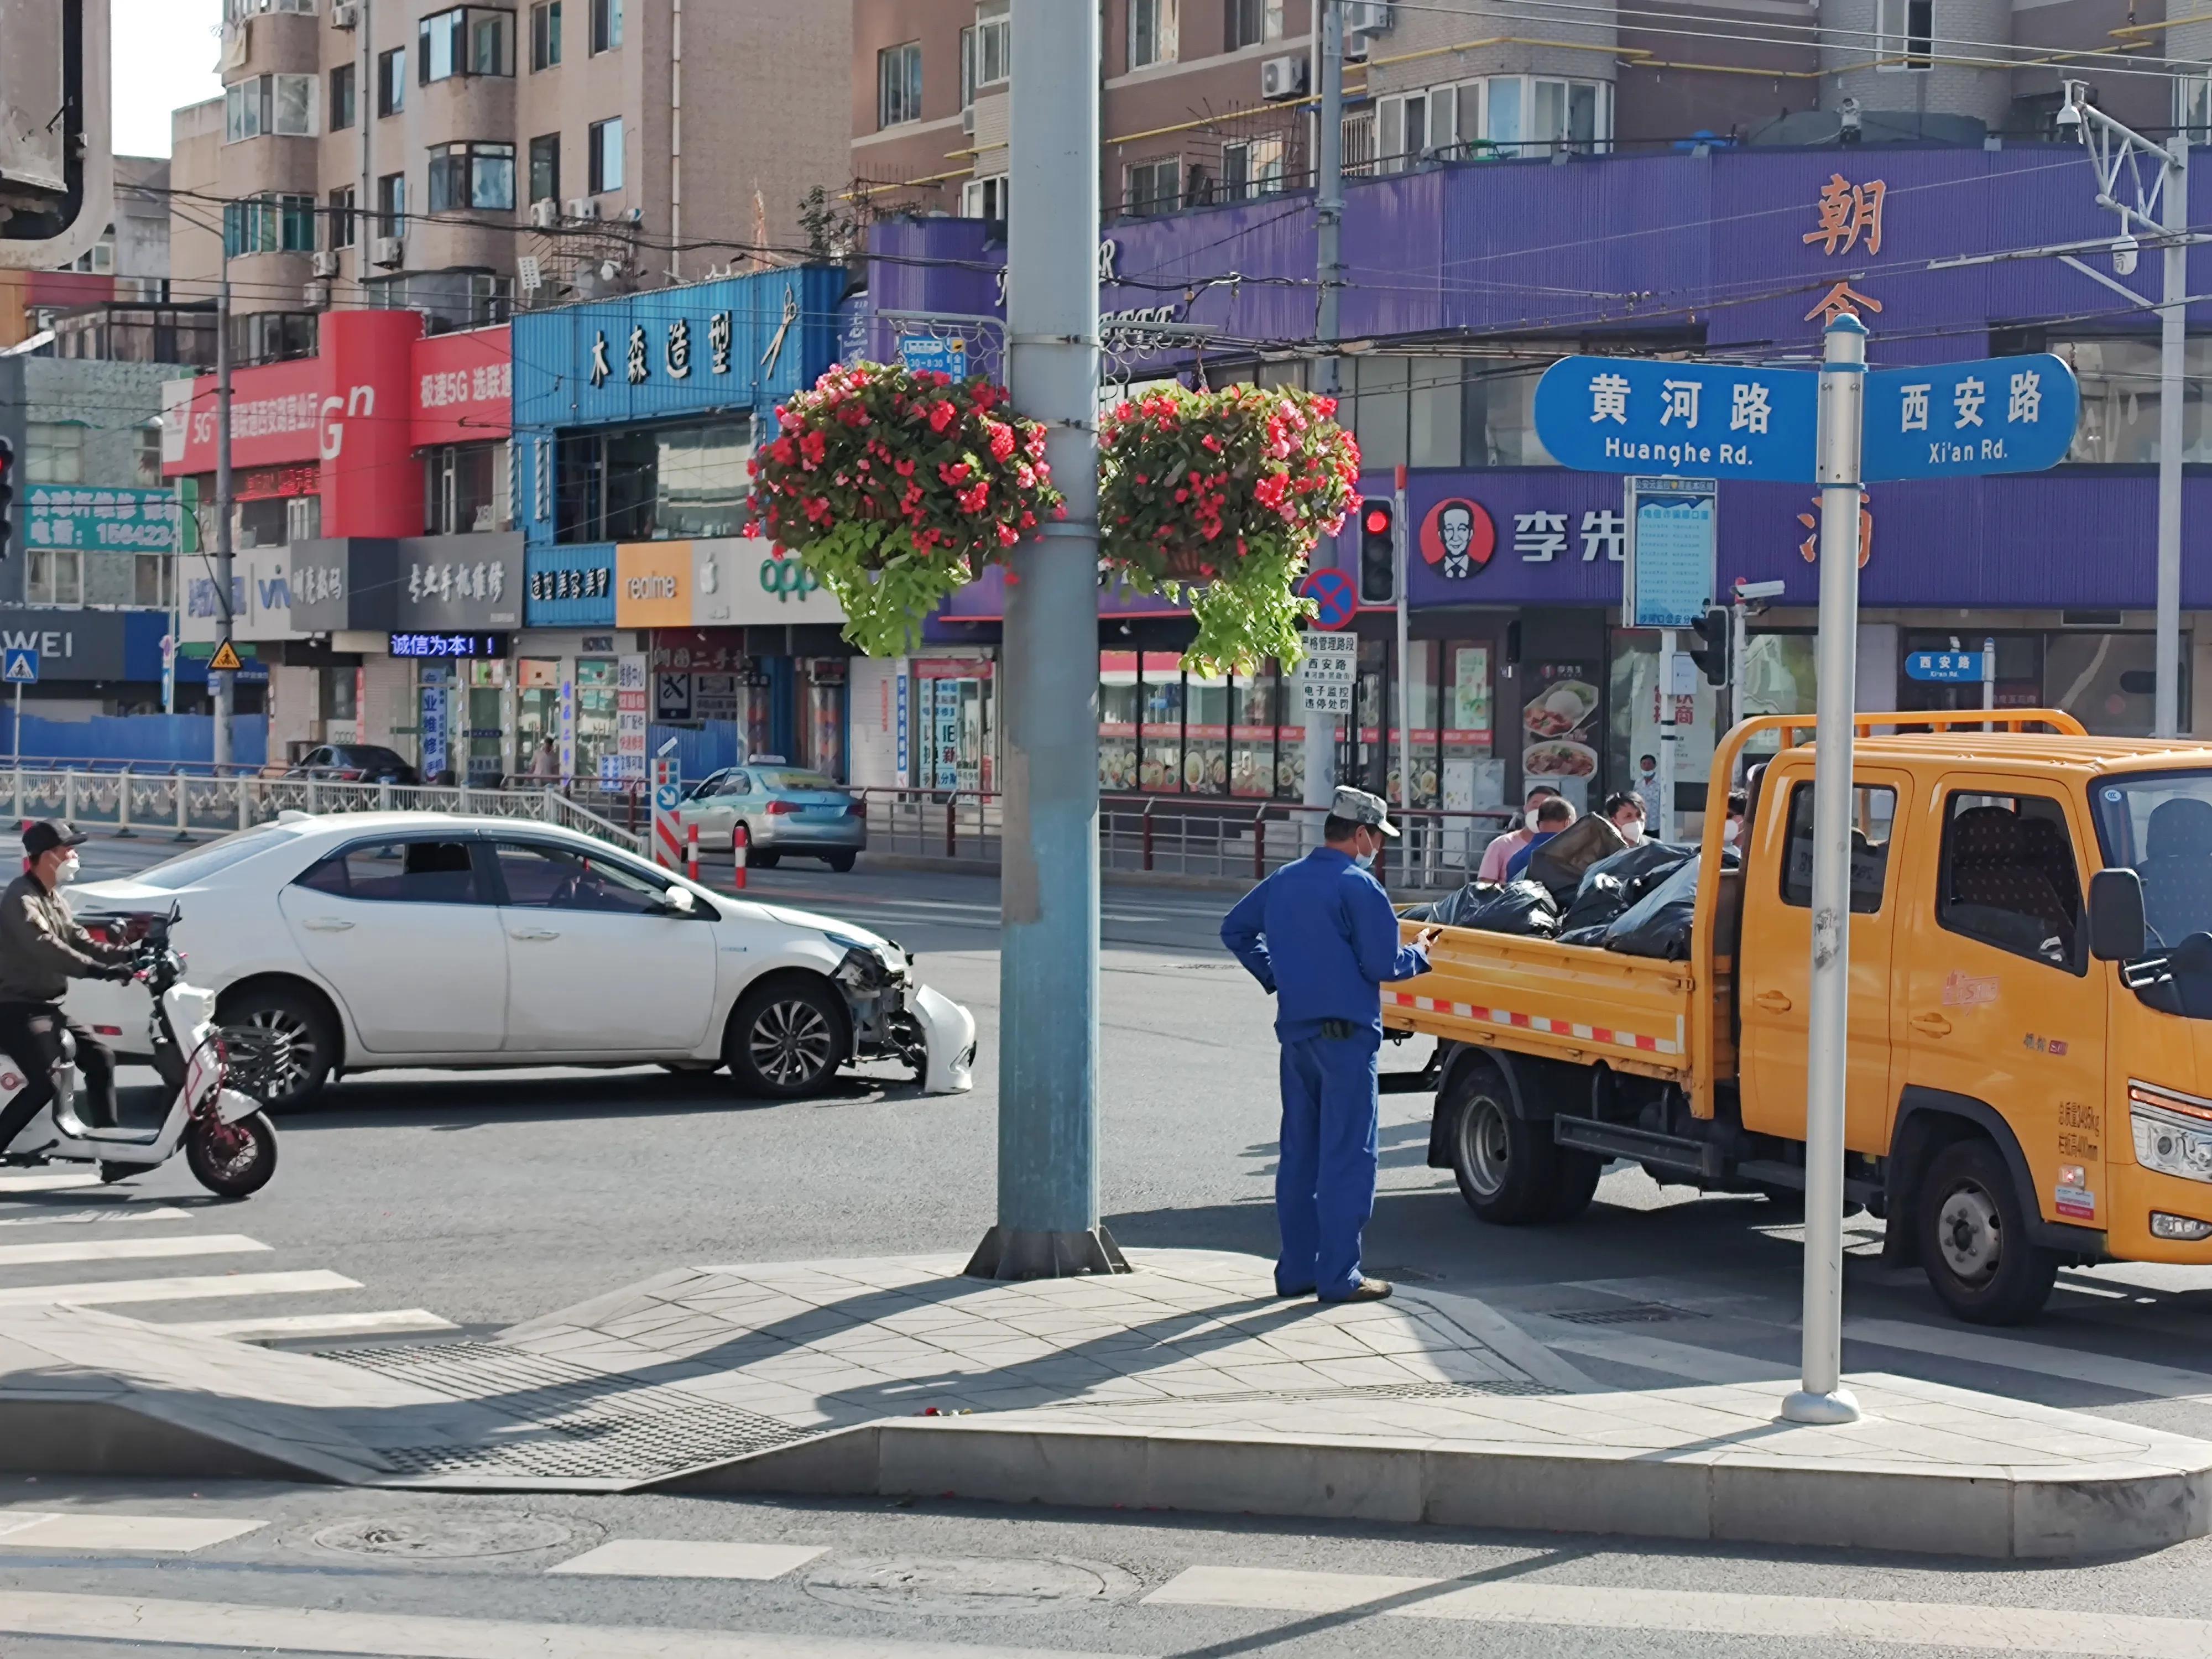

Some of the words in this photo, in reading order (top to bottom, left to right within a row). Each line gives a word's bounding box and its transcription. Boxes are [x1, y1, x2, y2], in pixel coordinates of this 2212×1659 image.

[585, 309, 735, 387] 木森造型
[1589, 373, 1772, 434] 黄河路
[1901, 370, 2042, 433] 西安路
[229, 392, 319, 440] 国联通西安路营业厅
[1605, 437, 1711, 468] Huanghe
[1719, 444, 1754, 465] Rd.
[1929, 441, 1974, 463] Xi'an
[1981, 439, 2008, 460] Rd.
[1513, 509, 1625, 562] 李先
[627, 573, 677, 599] realme
[1, 630, 72, 658] WEI
[1308, 658, 1346, 671] 西安路
[1919, 656, 1970, 669] 西安路
[1305, 686, 1349, 697] 电子监控
[1305, 698, 1349, 709] 违停处罚
